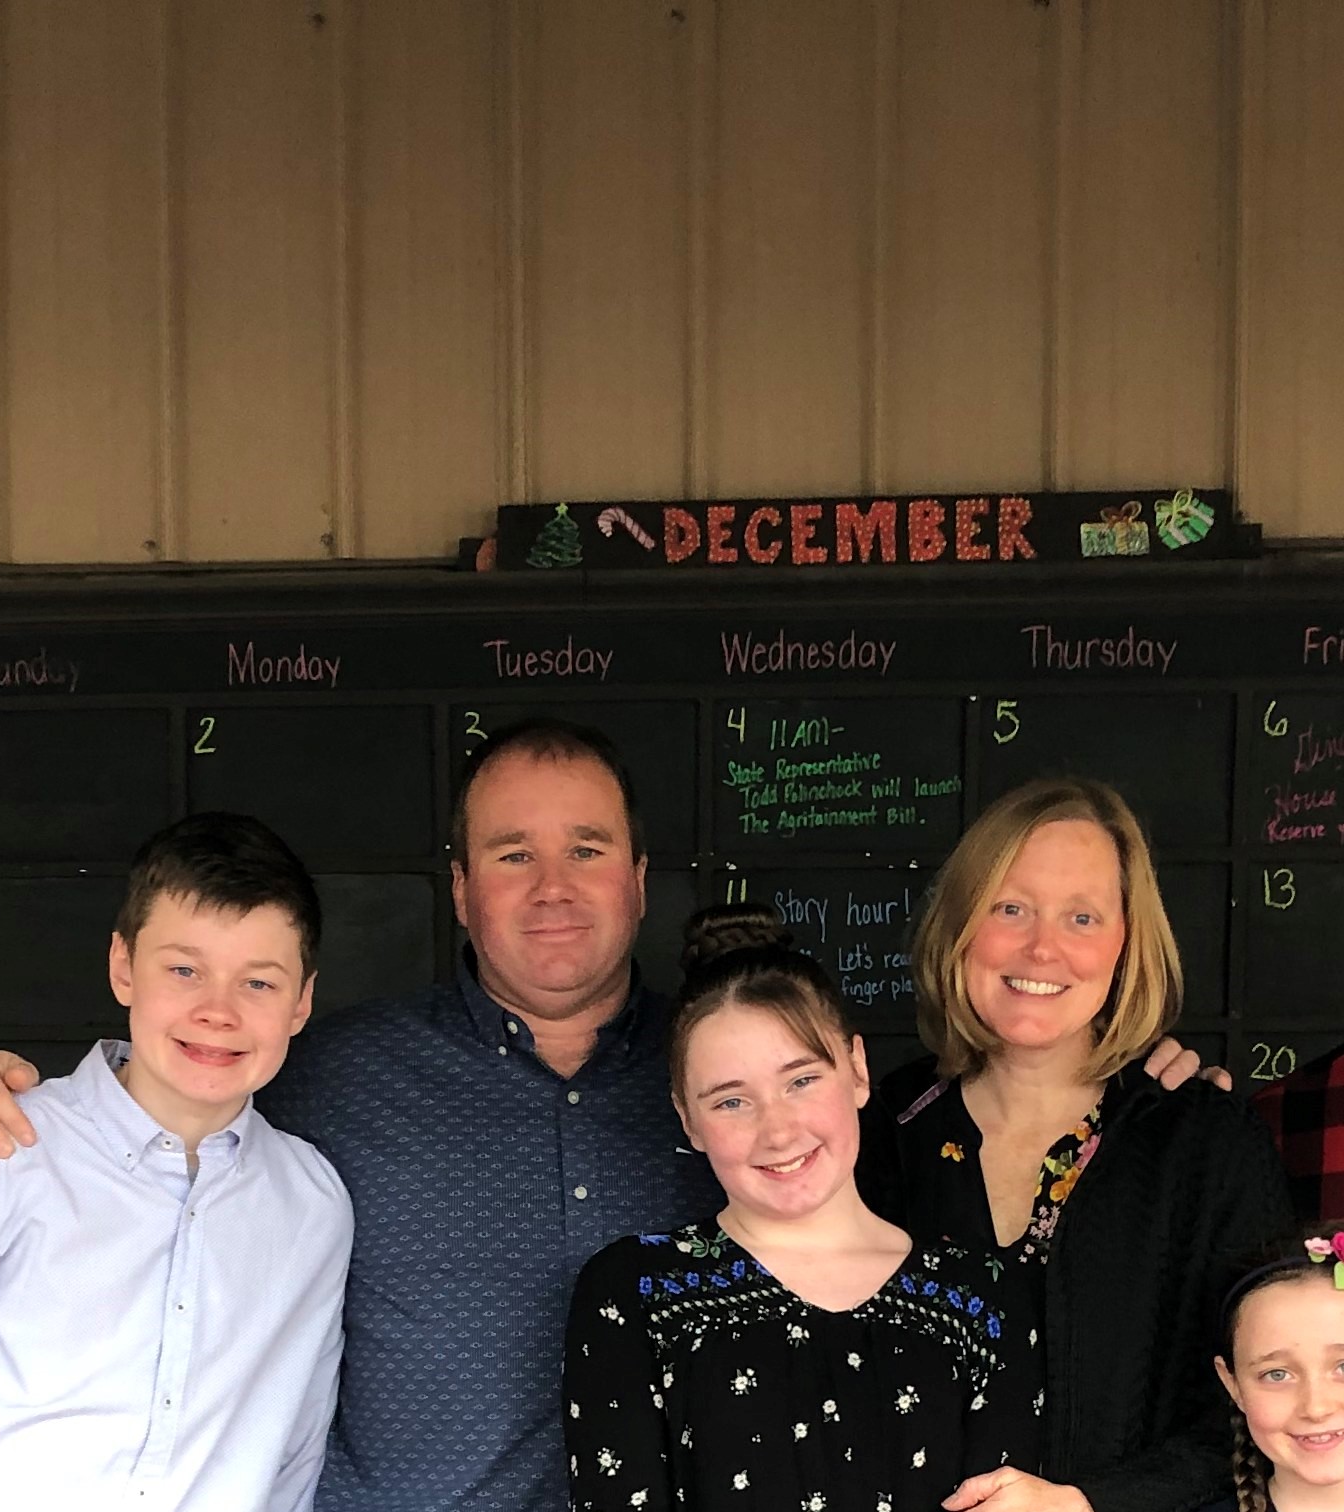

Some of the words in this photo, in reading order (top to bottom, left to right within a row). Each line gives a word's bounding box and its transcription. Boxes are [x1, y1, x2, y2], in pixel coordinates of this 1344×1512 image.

[662, 497, 1038, 566] DECEMBER
[227, 642, 342, 688] Monday
[484, 634, 614, 683] Tuesday
[721, 630, 897, 676] Wednesday
[1020, 624, 1178, 674] Thursday
[193, 716, 218, 754] 2
[727, 706, 746, 744] 4
[993, 699, 1020, 744] 5
[1263, 700, 1288, 737] 6
[723, 760, 766, 786] State
[776, 752, 881, 781] Representative
[740, 783, 778, 809] Todd
[871, 776, 901, 799] will
[914, 774, 962, 797] launch
[739, 813, 770, 835] The
[886, 806, 926, 826] Bill.
[1261, 868, 1297, 909] 13
[774, 889, 828, 943] Story
[846, 887, 912, 926] hour!
[838, 942, 874, 972] Let's
[883, 952, 913, 969] rea
[841, 976, 886, 1006] finger
[891, 977, 914, 1001] pla
[1249, 1042, 1297, 1082] 20
